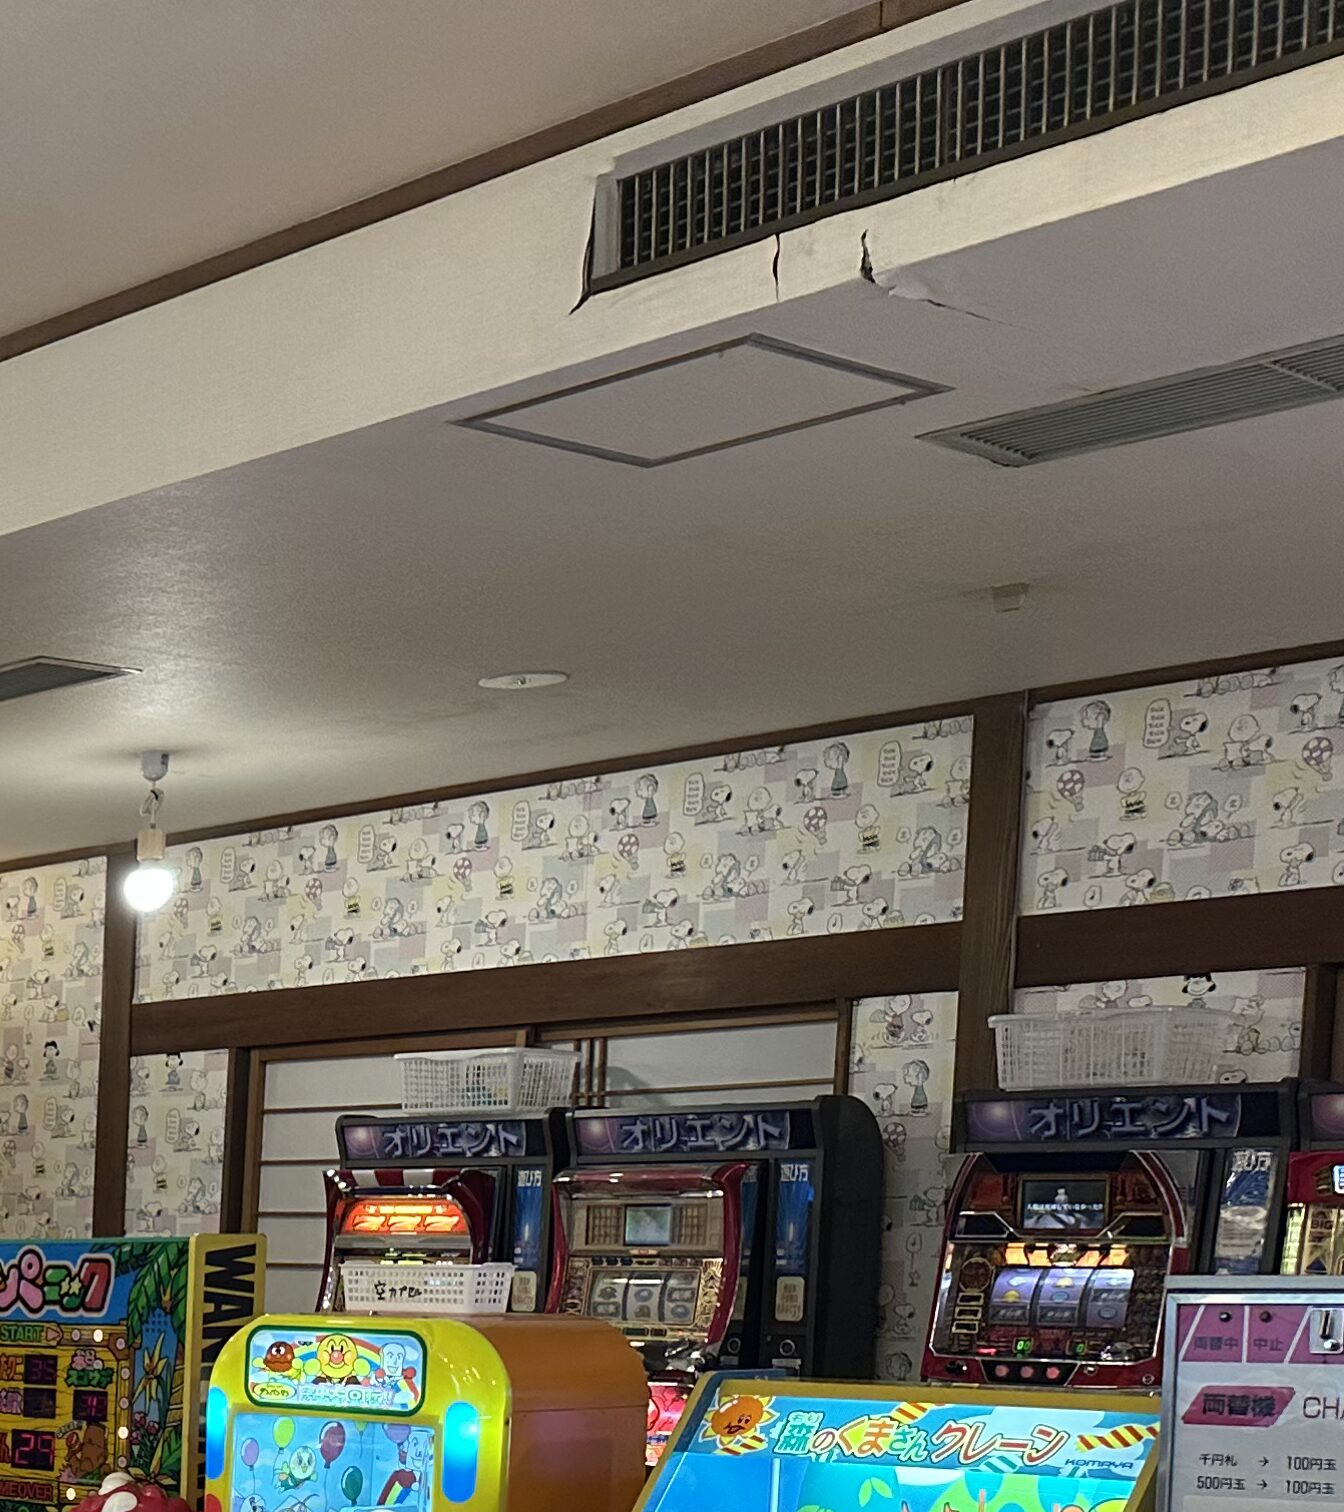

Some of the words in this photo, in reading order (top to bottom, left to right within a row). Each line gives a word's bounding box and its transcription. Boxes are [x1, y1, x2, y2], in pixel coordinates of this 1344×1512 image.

[1028, 1099, 1231, 1138] オリエント
[384, 1123, 521, 1157] オリエント
[621, 1113, 786, 1152] オリエント
[0, 1325, 45, 1343] START
[1253, 1338, 1285, 1351] 中止
[1202, 1393, 1276, 1418] 両替機
[1303, 1396, 1344, 1420] CH
[1064, 1458, 1134, 1470] KOMAYA
[1199, 1453, 1238, 1467] 千円札
[1287, 1455, 1337, 1471] 100円玉
[1196, 1475, 1246, 1491] 500円玉
[1285, 1480, 1336, 1495] 100円玉
